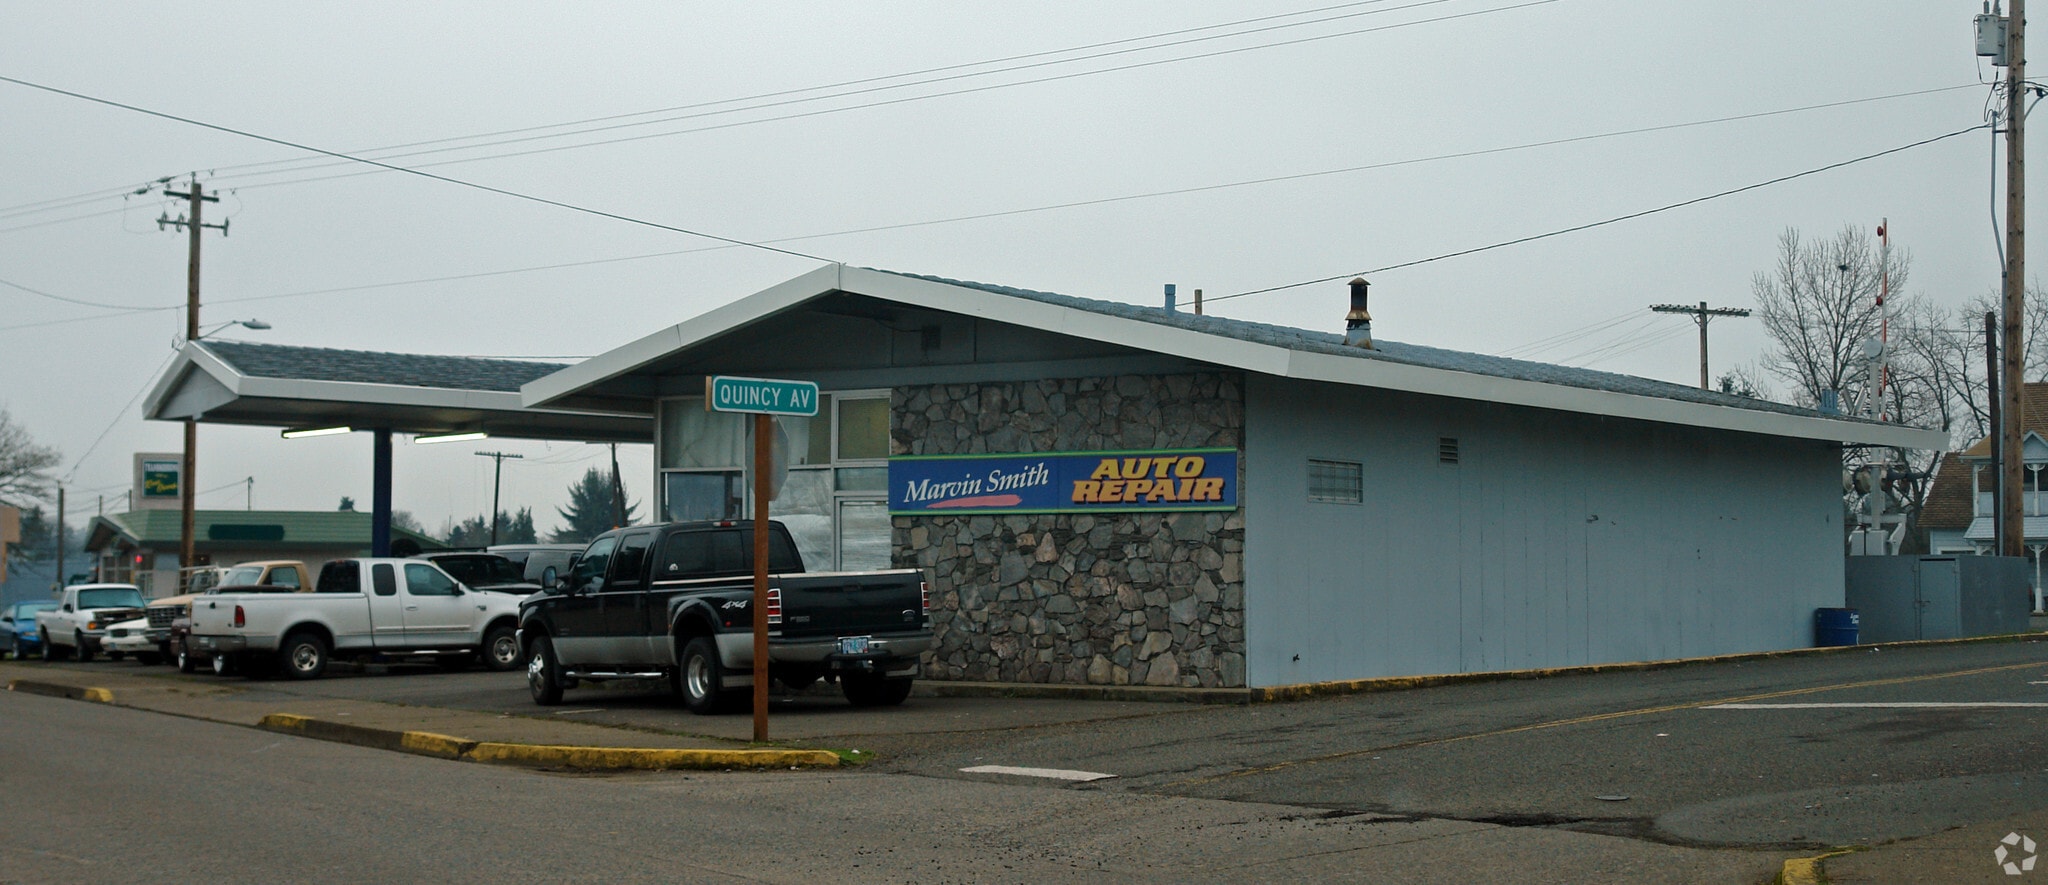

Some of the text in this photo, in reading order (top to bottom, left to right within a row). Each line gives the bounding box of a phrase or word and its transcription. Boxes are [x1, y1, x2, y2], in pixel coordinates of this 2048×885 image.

[721, 384, 811, 409] QUINCY AV
[1090, 455, 1206, 480] AUTO
[903, 461, 1050, 503] Marvin Smith
[1071, 477, 1225, 503] REPAIR
